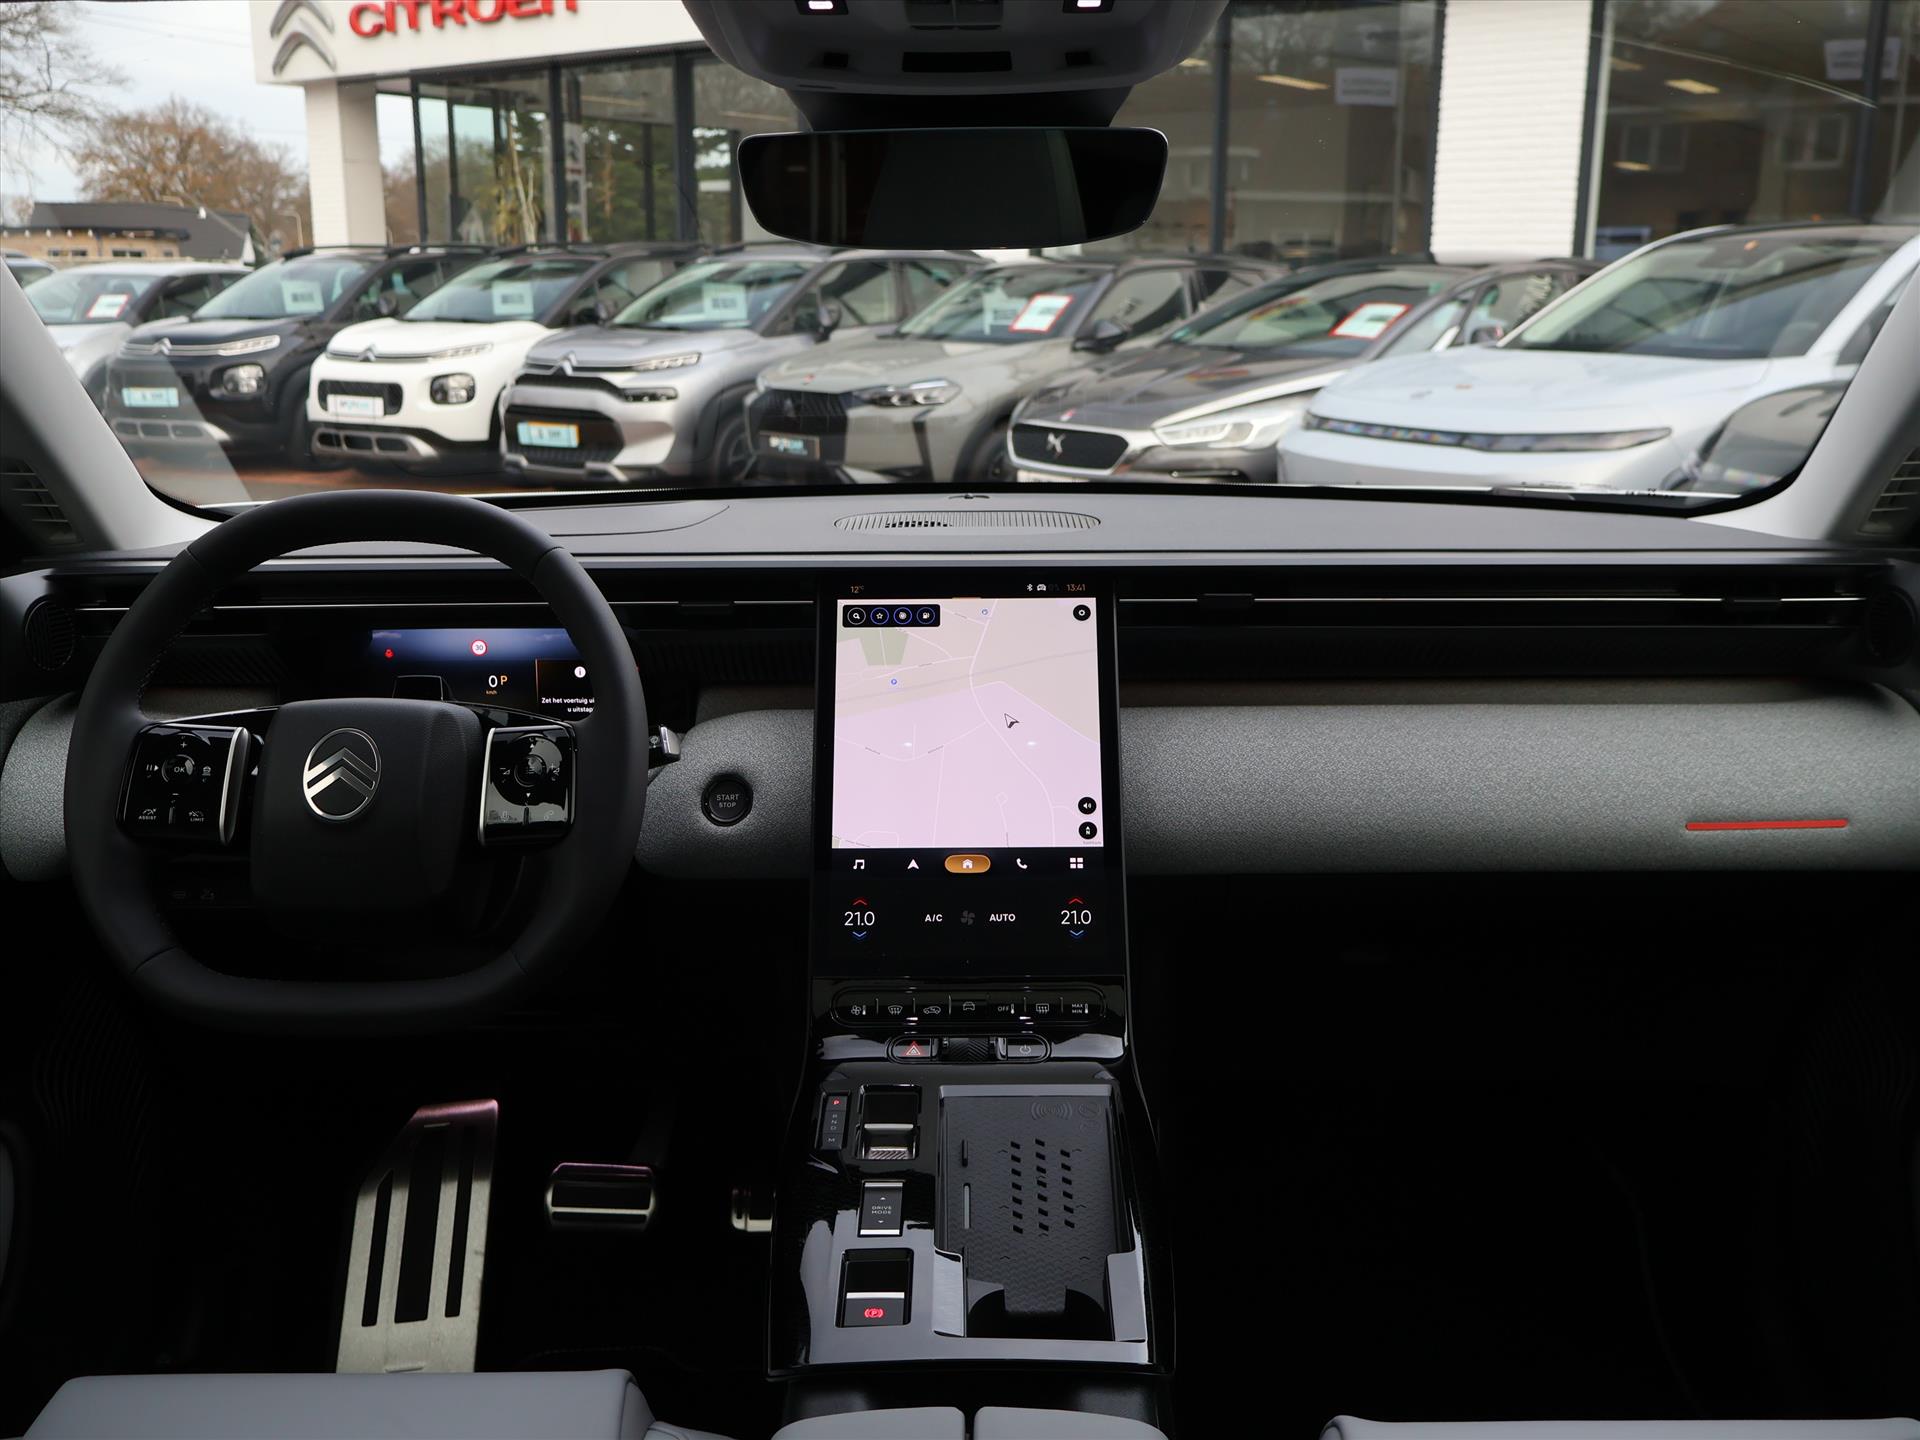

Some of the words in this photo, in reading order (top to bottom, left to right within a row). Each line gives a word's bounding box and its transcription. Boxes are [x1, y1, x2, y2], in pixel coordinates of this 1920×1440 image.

[1066, 583, 1086, 592] 13:41
[488, 675, 498, 688] 0
[500, 675, 508, 686] P
[563, 697, 588, 705] voertuig
[844, 911, 875, 926] 21.0
[924, 913, 943, 922] A/C
[989, 913, 1016, 922] AUTO
[1060, 909, 1092, 926] 21.0
